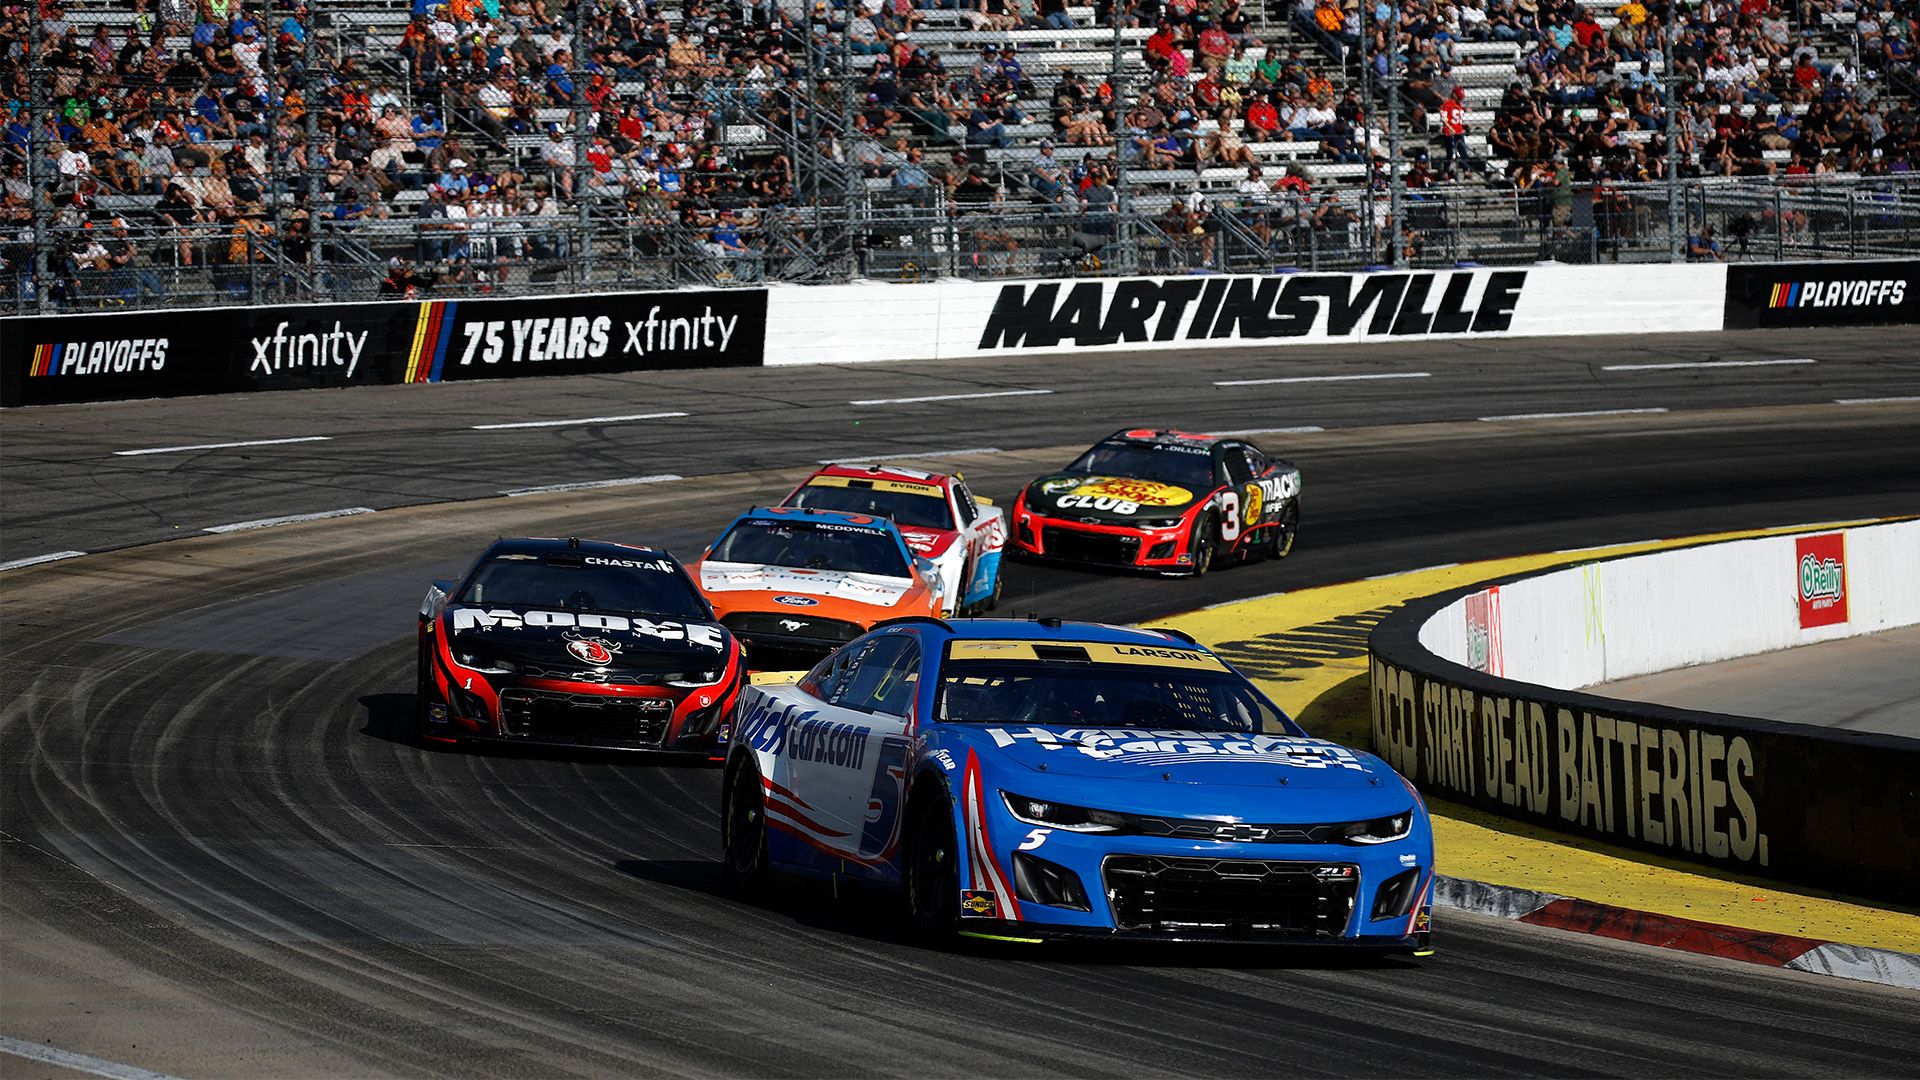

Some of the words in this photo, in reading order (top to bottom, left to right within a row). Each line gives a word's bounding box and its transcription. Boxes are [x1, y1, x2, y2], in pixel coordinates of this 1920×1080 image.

[978, 271, 1528, 350] MARTINSVILLE
[1798, 280, 1908, 308] PLAYOFFS
[250, 320, 369, 379] xfinity
[460, 321, 506, 366] 75
[511, 315, 612, 362] YEARS
[622, 305, 739, 357] xfinity
[60, 338, 169, 376] PLAYOFFS
[890, 482, 930, 492] BYRON
[1056, 494, 1141, 515] CLUB
[815, 523, 887, 537] MCDOWELL
[1221, 491, 1241, 542] 3
[1801, 555, 1842, 599] O'Reilly
[1112, 646, 1202, 662] LARSON
[463, 677, 473, 690] 1
[1423, 679, 1476, 797] START
[1481, 695, 1550, 815] DEAD
[1557, 707, 1769, 866] BATTERIES.
[1018, 828, 1053, 851] 5
